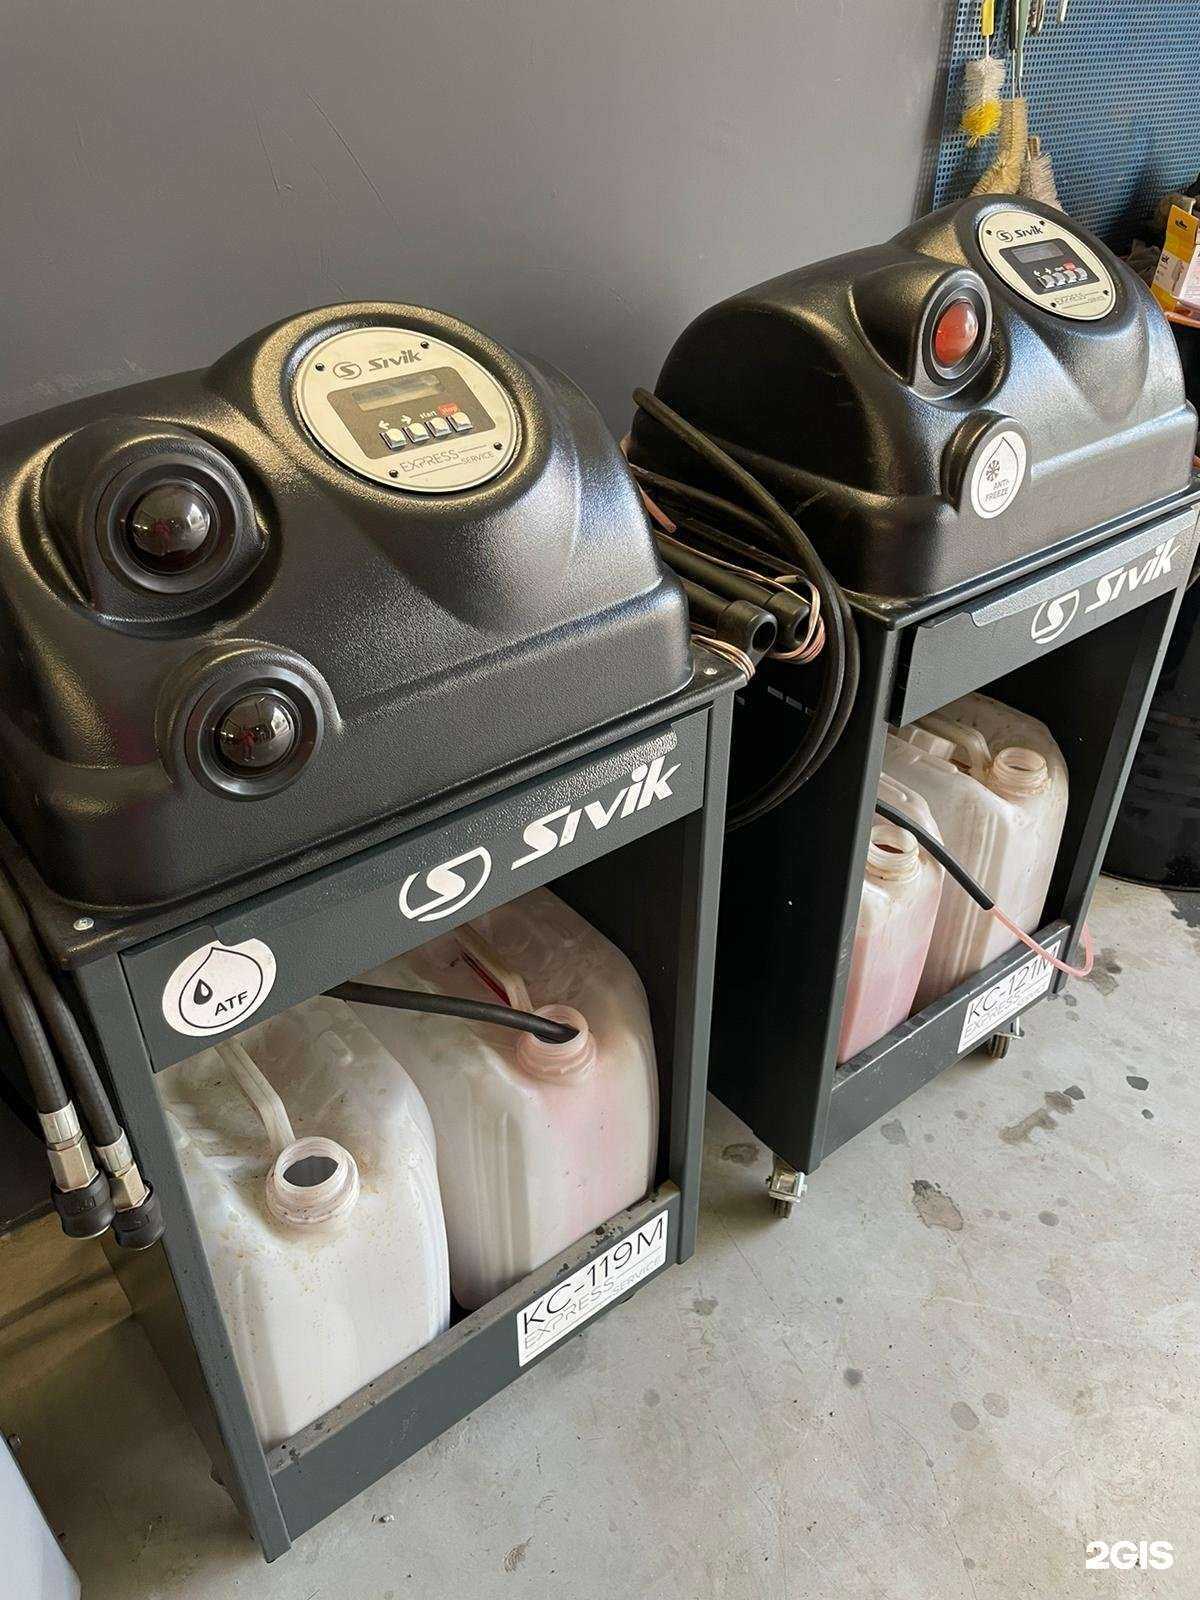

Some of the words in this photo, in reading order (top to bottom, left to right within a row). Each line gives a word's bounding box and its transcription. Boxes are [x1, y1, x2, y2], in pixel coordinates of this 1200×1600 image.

[400, 449, 459, 473] EXPRESS
[460, 450, 495, 466] SERVICE
[984, 488, 1009, 502] FREEZE
[214, 990, 248, 1017] ATF
[523, 1217, 664, 1335] KC-119M
[524, 1276, 616, 1350] EXPRESS
